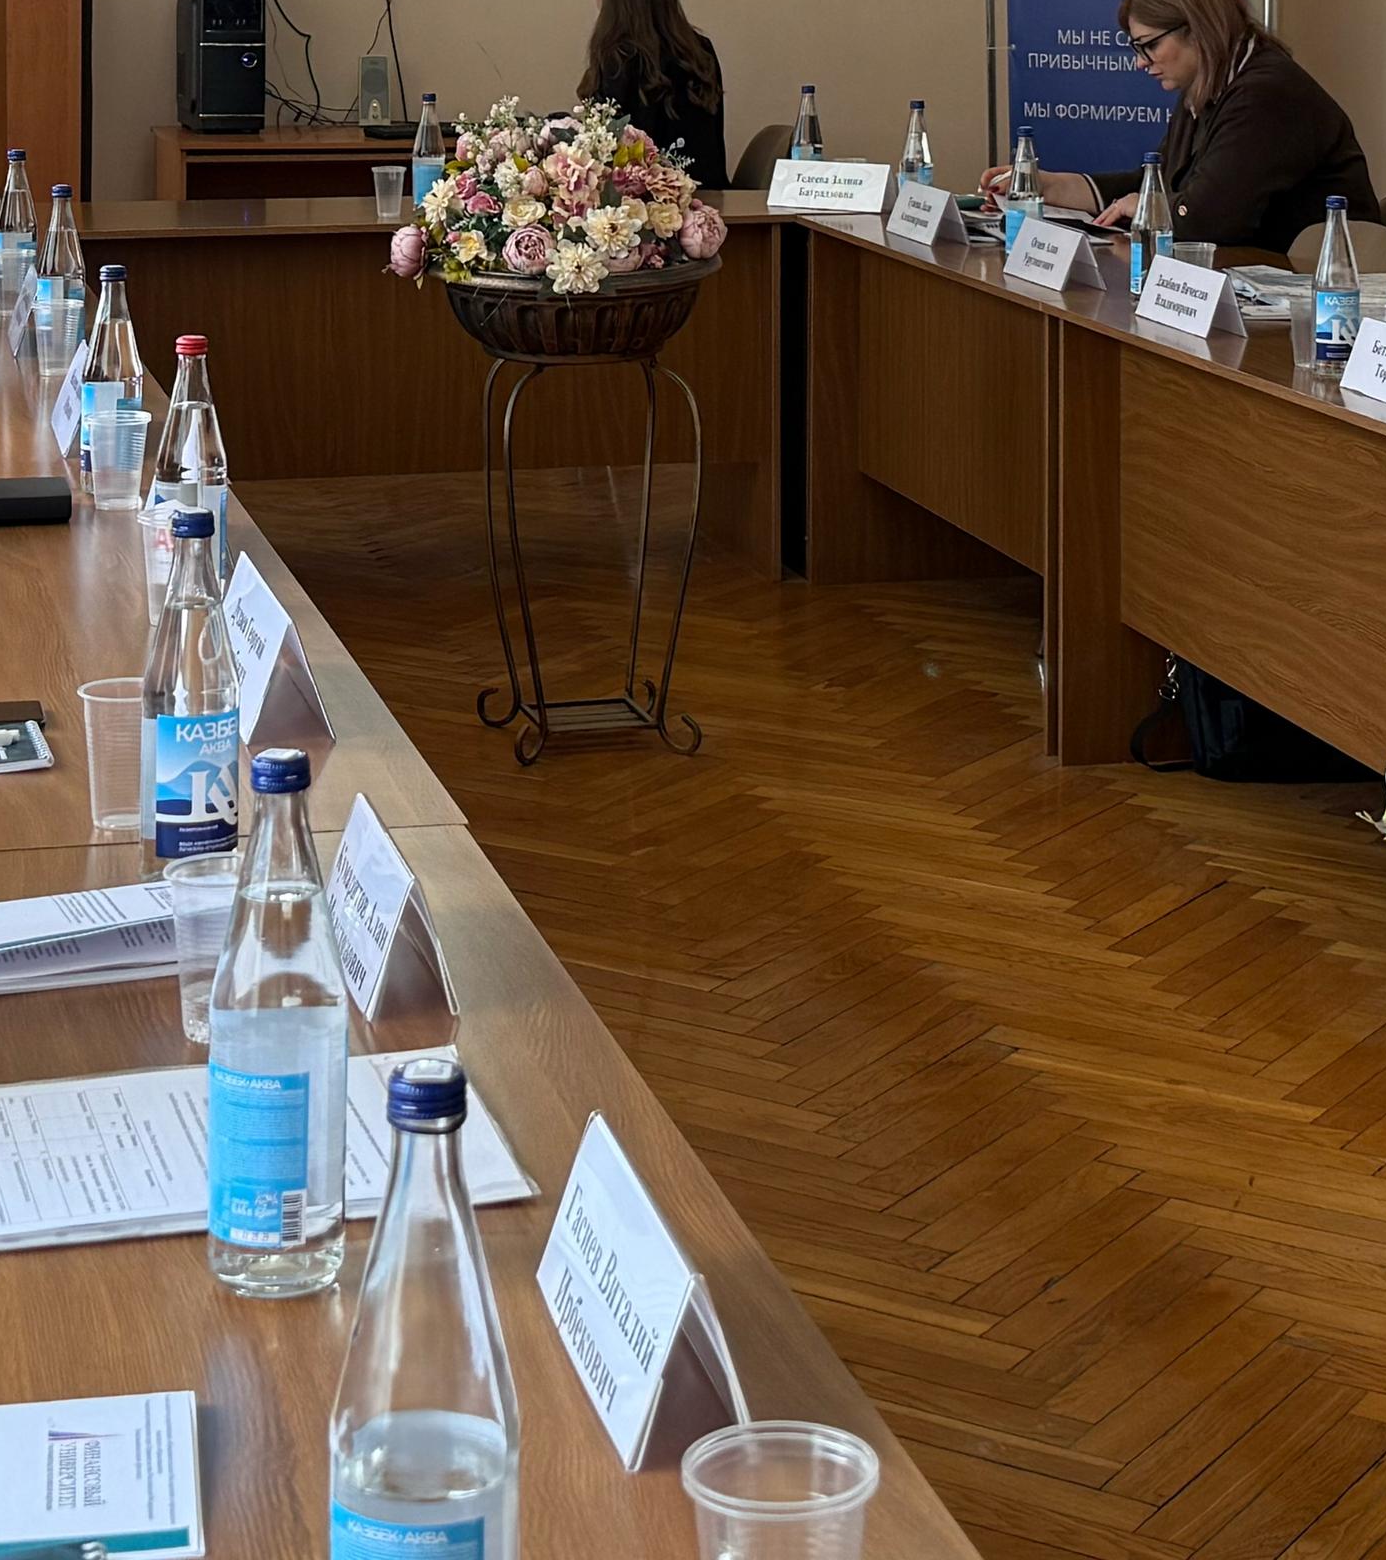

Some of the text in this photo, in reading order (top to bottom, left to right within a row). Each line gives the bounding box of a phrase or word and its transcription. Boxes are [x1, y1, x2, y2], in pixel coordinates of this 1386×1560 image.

[1057, 29, 1085, 45] МЫ
[1090, 30, 1111, 46] НЕ
[1024, 102, 1051, 118] МЫ
[1055, 103, 1161, 123] ФОРМИРУЕМ
[175, 716, 237, 743] КАЗБЕ
[199, 739, 232, 757] АКВА
[363, 900, 390, 953] Алан
[249, 1078, 282, 1090] АКВА
[597, 1248, 660, 1376] Виталий
[553, 1265, 619, 1415] Ирбекович
[57, 1441, 77, 1509] УНИВЕРСИТЕТ
[82, 1439, 107, 1507] ФИНАНСОВЫЙ
[402, 1530, 449, 1544] АКВА
